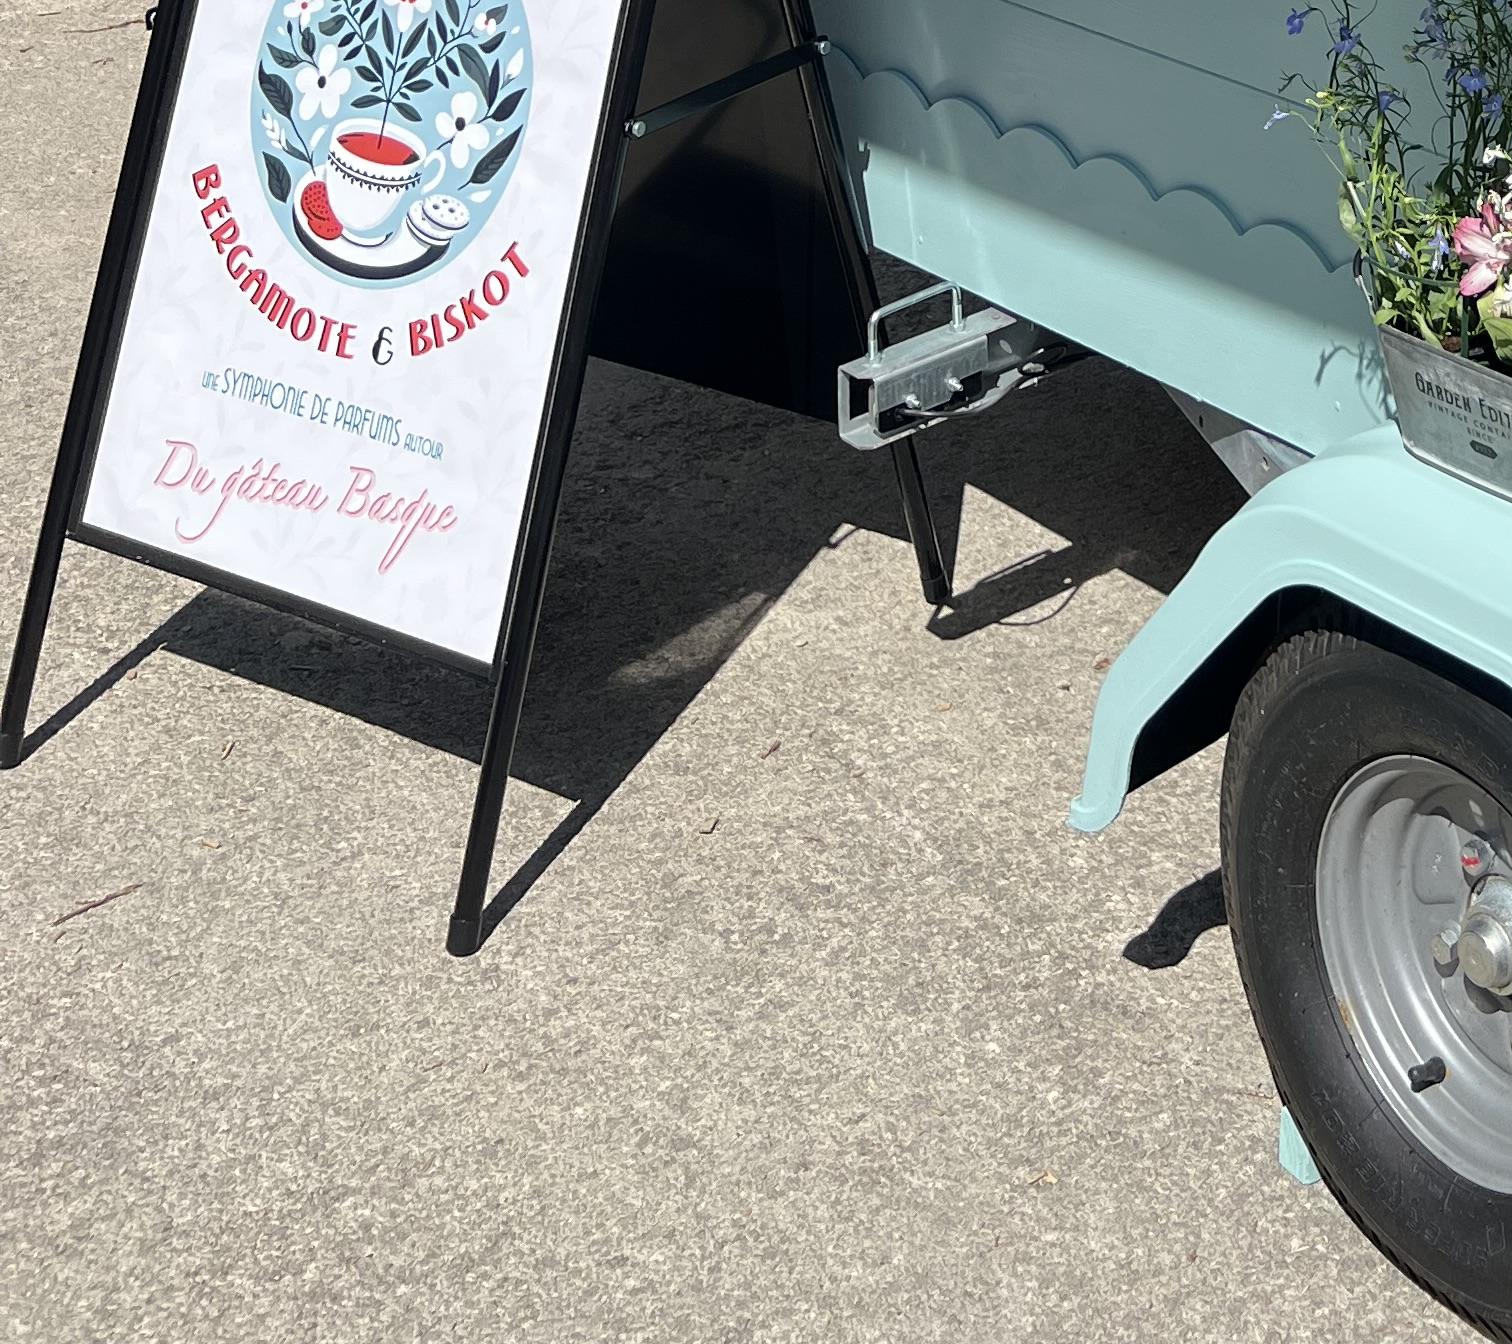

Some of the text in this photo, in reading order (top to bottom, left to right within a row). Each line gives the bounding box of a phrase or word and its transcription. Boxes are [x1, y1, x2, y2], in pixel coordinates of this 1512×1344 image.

[191, 163, 531, 366] BERGAMOTE & BISKOT
[220, 367, 308, 417] SYMPHONIE
[309, 393, 333, 425] DE
[333, 399, 404, 447] PARFUMS
[403, 432, 445, 461] AUTOUR
[1428, 401, 1469, 423] VINTAGE
[153, 438, 459, 575] Du gâteau Basque
